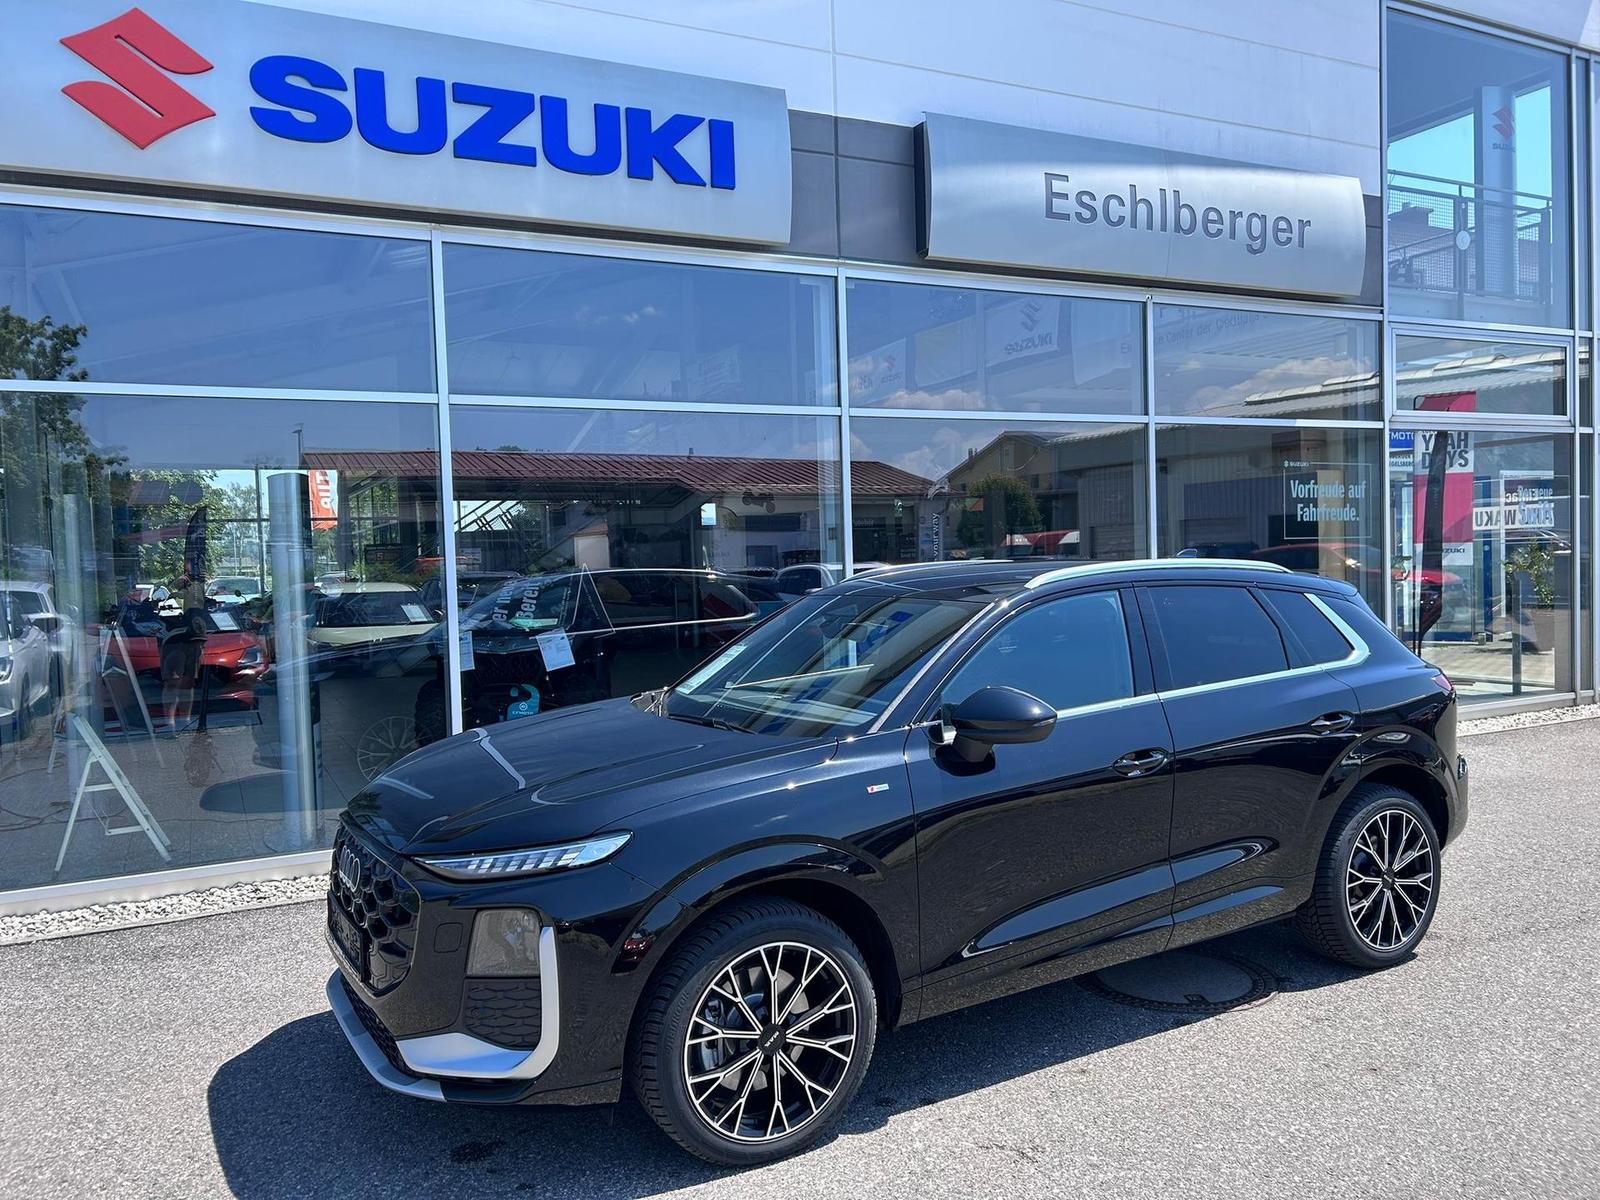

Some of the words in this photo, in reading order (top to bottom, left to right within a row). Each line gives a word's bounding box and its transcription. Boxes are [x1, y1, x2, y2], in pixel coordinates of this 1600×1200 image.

[249, 55, 736, 190] SUZUKI
[1044, 172, 1311, 255] Eschlberger
[1421, 432, 1469, 451] YAH
[1421, 449, 1469, 468] DYS
[1290, 480, 1345, 498] Vorfreude
[1348, 481, 1367, 498] auf
[932, 512, 941, 533] way
[1297, 504, 1360, 522] Fahrfreude.
